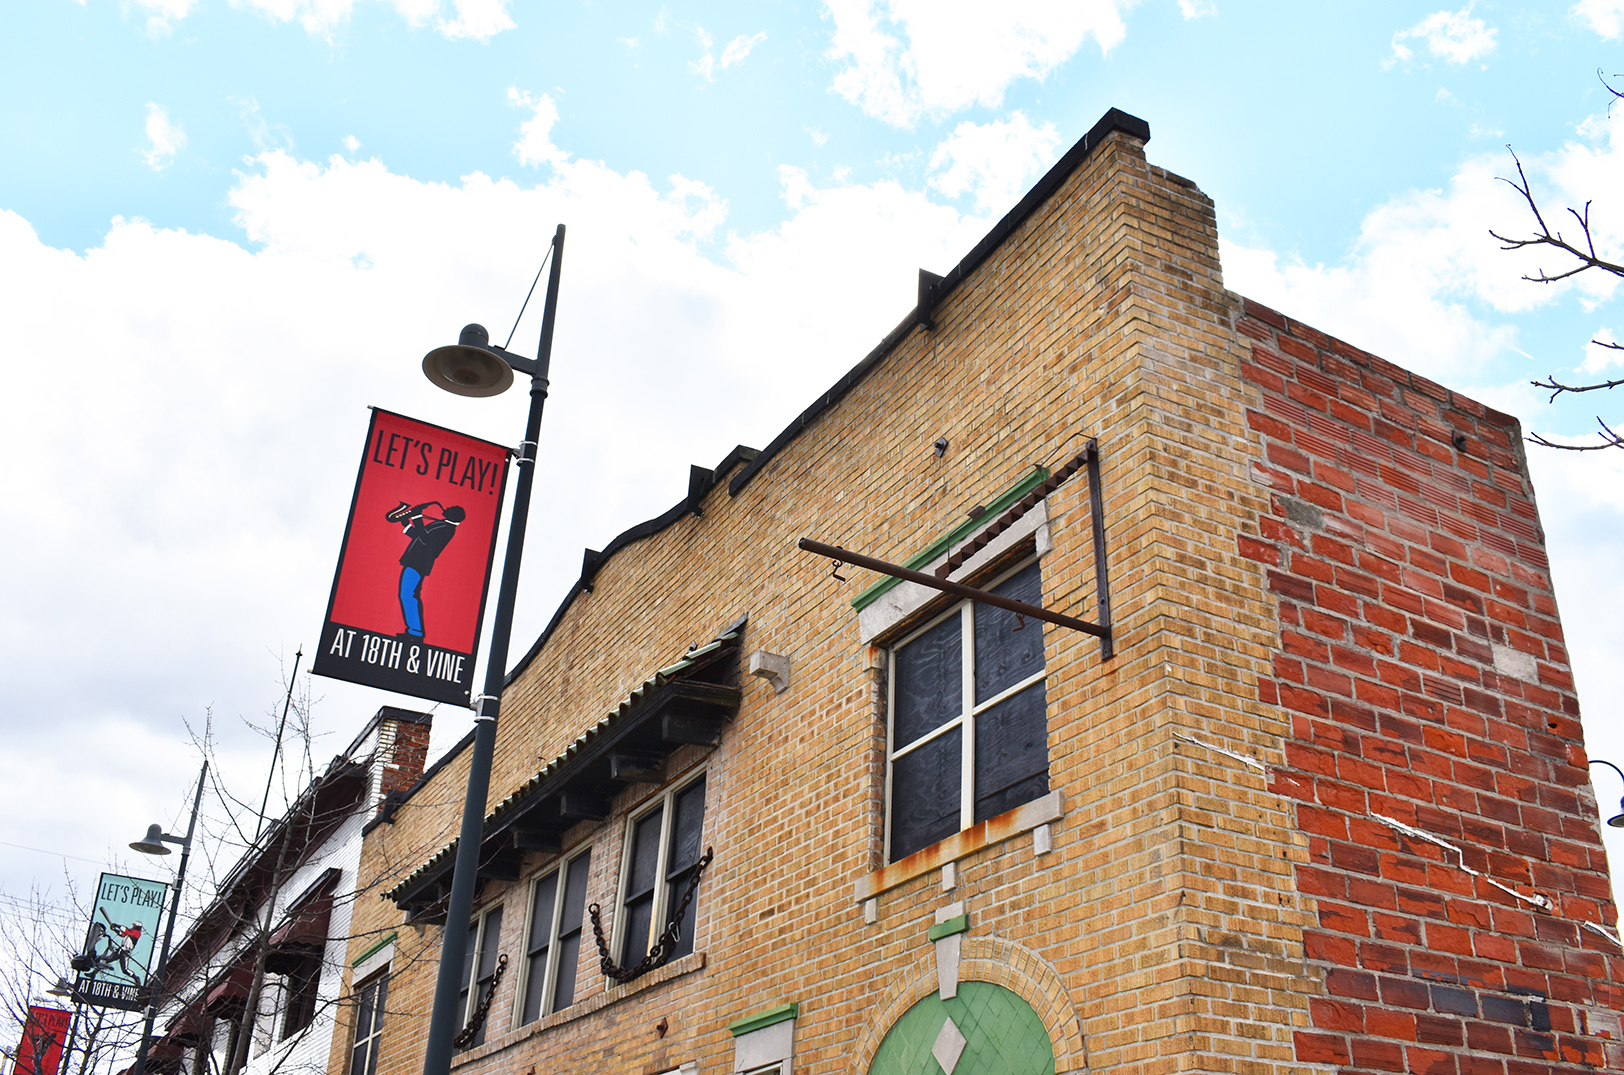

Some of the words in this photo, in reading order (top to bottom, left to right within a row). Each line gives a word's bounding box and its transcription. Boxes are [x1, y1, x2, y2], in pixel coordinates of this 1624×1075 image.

[373, 429, 433, 476] LET'S
[435, 447, 498, 496] PLAY!
[329, 628, 357, 659] AT
[360, 634, 404, 670] 18TH
[406, 645, 421, 674] &
[426, 649, 466, 684] VINE
[101, 882, 130, 904] LET'S
[130, 887, 162, 909] PLAY!
[77, 979, 91, 994] AT
[91, 981, 112, 998] 18TH
[112, 984, 120, 999] &
